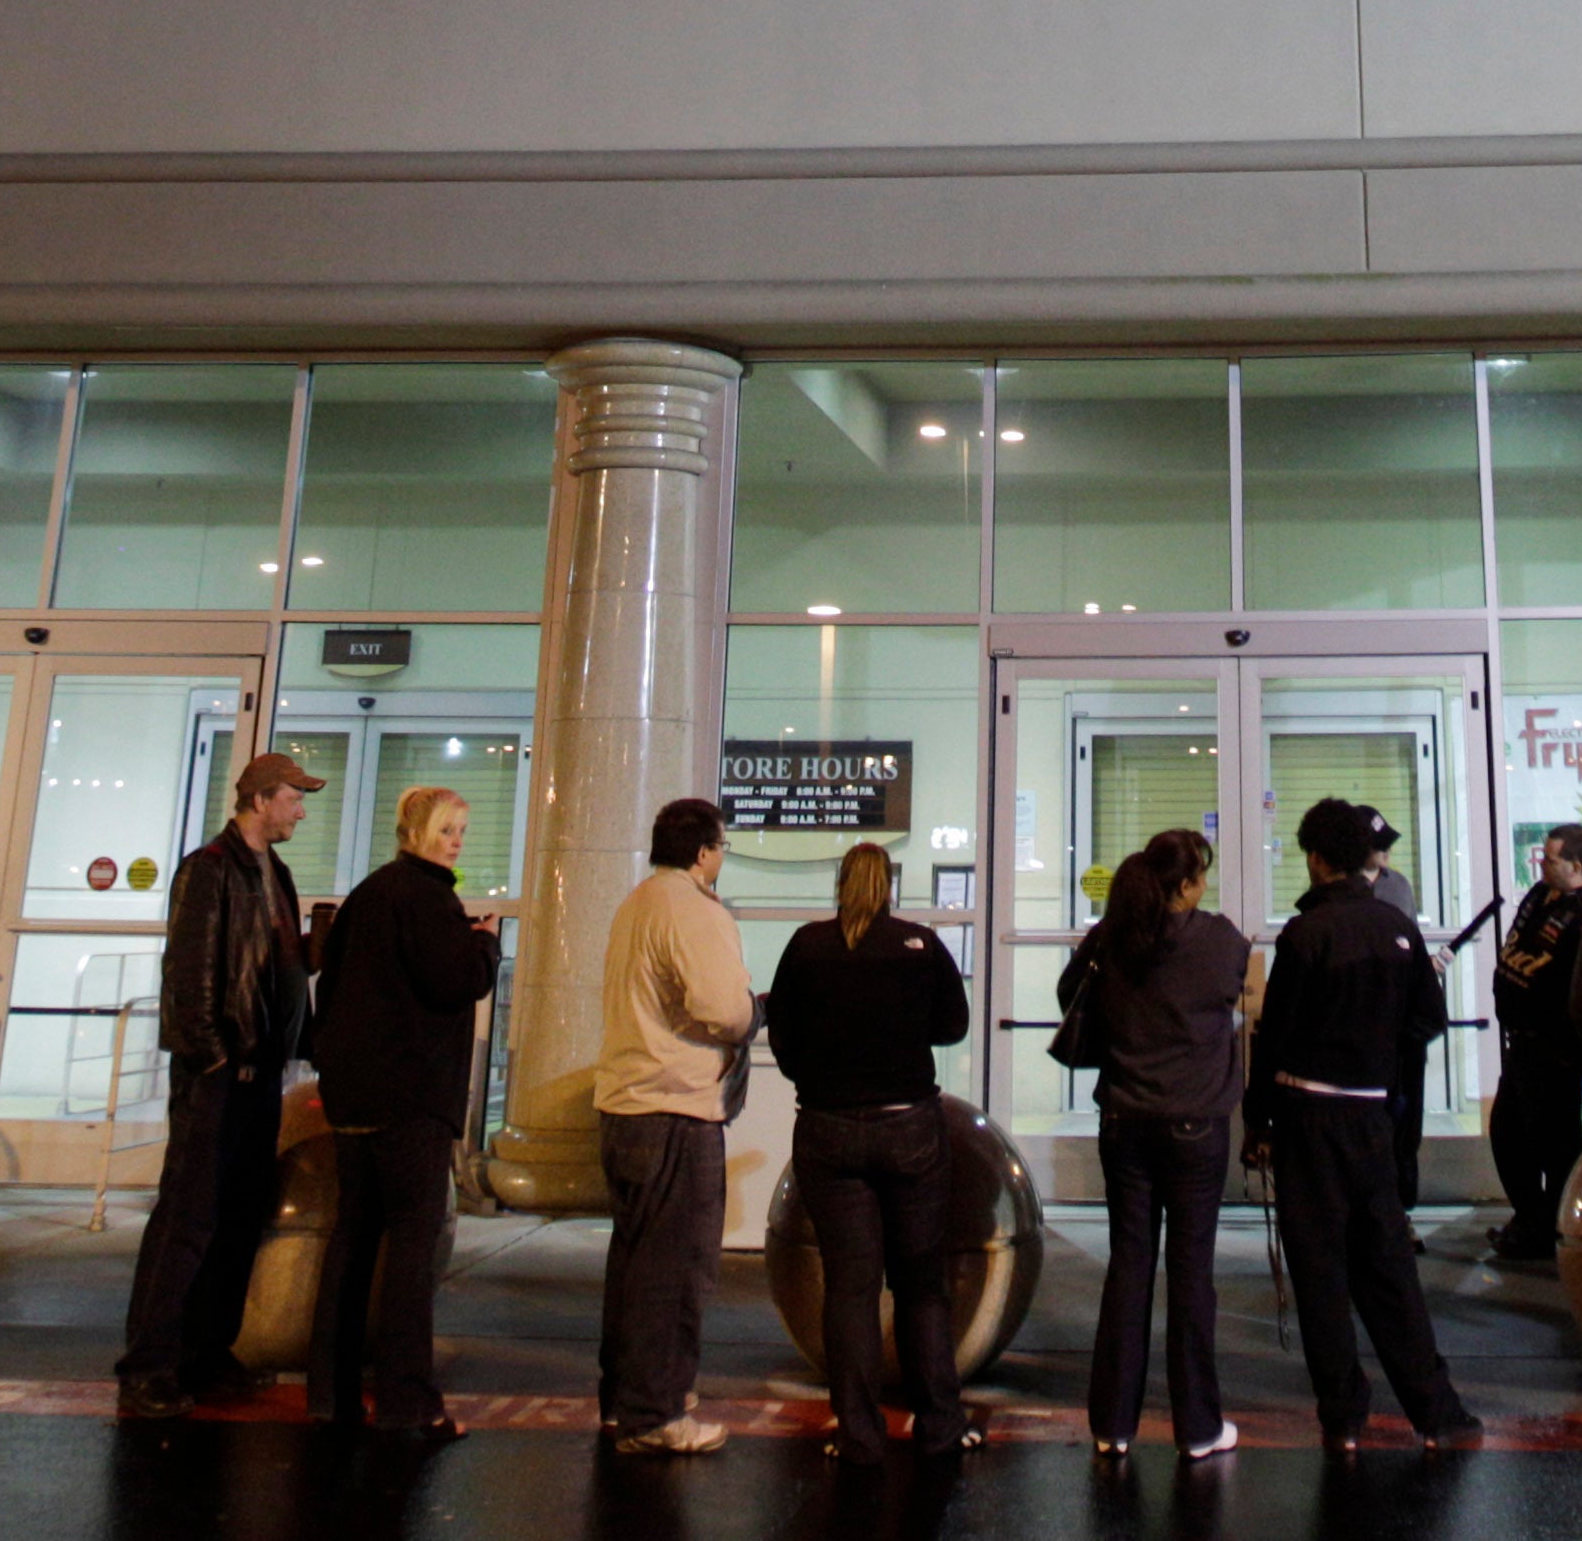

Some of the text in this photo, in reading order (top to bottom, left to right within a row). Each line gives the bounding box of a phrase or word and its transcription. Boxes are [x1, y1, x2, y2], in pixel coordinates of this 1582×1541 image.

[349, 643, 383, 656] EXIT
[721, 755, 899, 781] TORE HOURS
[760, 786, 788, 796] FRIDAY
[734, 799, 773, 809] SATURDAY
[734, 814, 765, 824] SUNDAY
